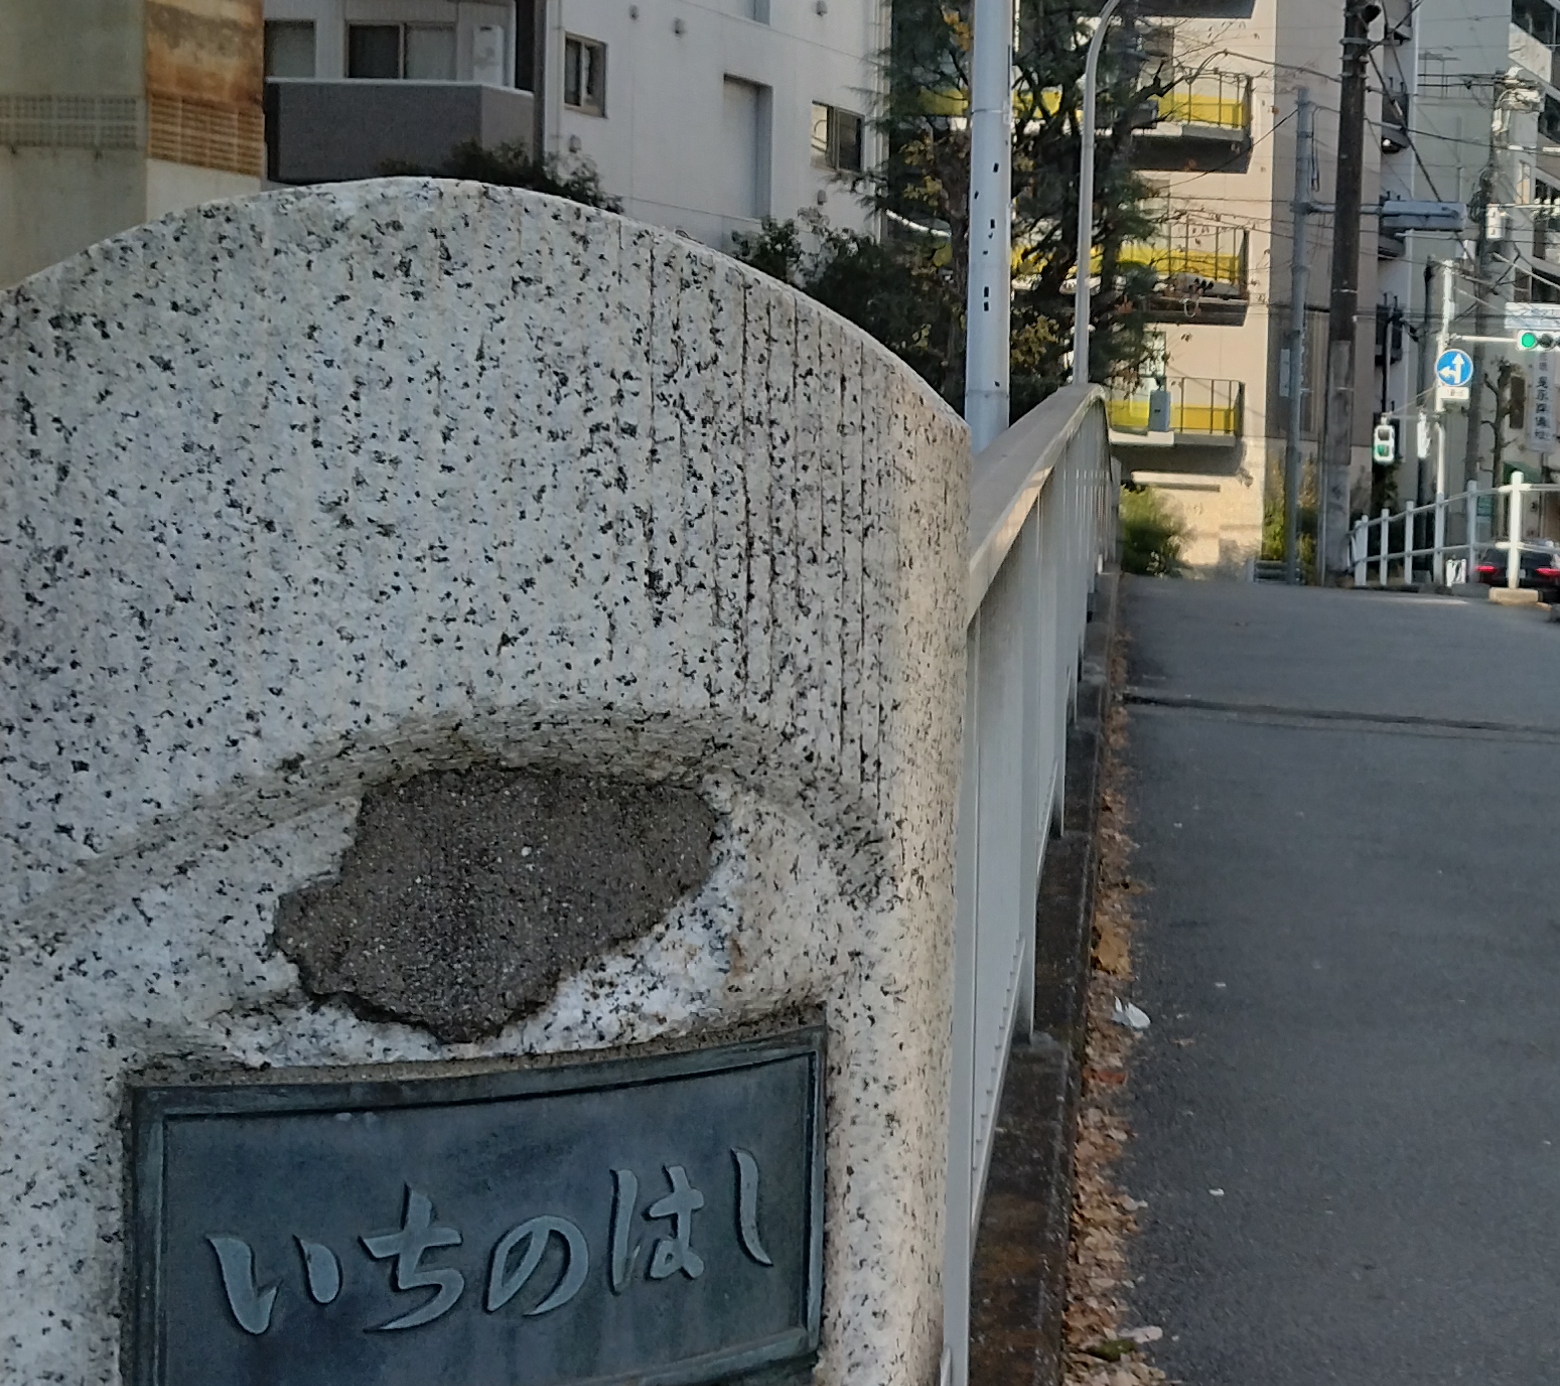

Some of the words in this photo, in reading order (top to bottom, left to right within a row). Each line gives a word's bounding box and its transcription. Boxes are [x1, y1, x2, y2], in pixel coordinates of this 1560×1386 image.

[206, 1147, 774, 1335] いちのはし
